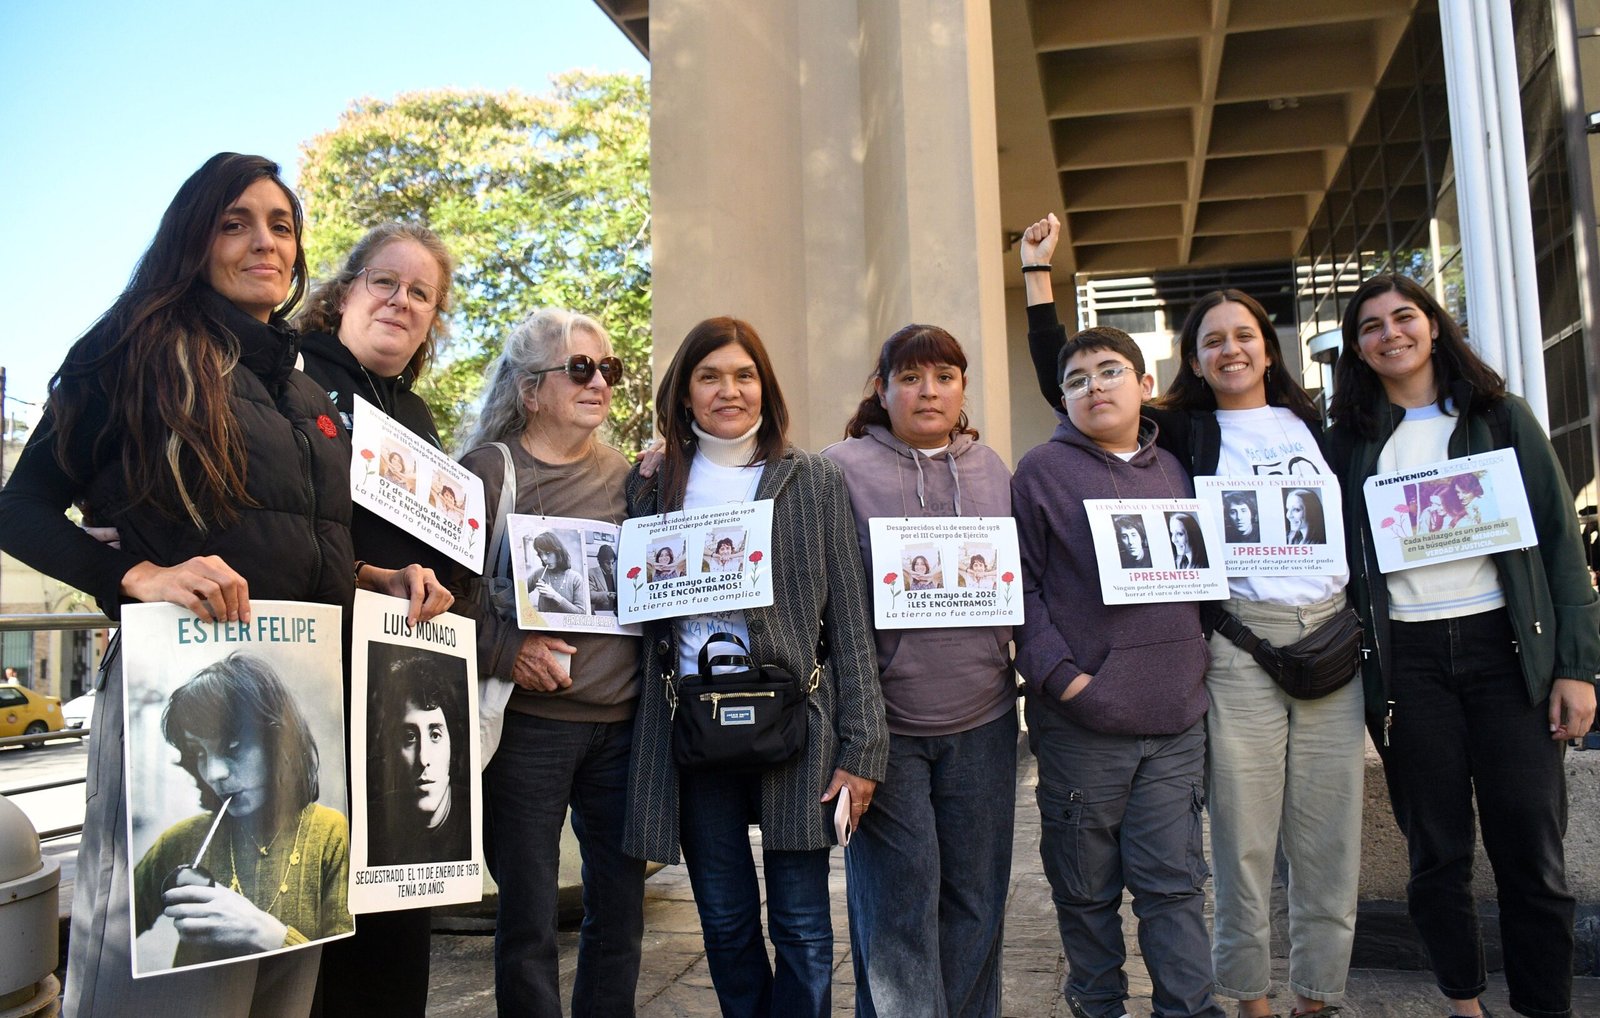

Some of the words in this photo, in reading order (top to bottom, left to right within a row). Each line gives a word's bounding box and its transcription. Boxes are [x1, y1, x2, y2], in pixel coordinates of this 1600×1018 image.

[1375, 469, 1438, 487] ¡BIENVENIDOS
[378, 487, 396, 504] ¡LES
[400, 500, 461, 543] ENCONTRAMOS!
[379, 478, 390, 490] 07
[392, 486, 402, 498] de
[405, 494, 428, 516] mayo
[431, 510, 441, 522] de
[442, 518, 462, 534] 2026
[355, 485, 367, 494] La
[371, 492, 400, 515] tierra
[402, 514, 414, 523] no
[417, 521, 432, 534] fue
[434, 532, 474, 559] complice
[638, 516, 685, 529] Desaparecidos
[740, 508, 755, 516] 1978
[650, 527, 660, 535] por
[679, 521, 703, 530] Cuerpo
[713, 516, 740, 525] Ejército
[1422, 532, 1453, 542] hallazgo
[1475, 525, 1492, 533] paso
[1426, 536, 1460, 549] búsqueda
[1233, 546, 1314, 555] ¡PRESENTES!
[662, 581, 673, 589] de
[676, 578, 702, 588] mayo
[720, 573, 742, 581] 2026
[1129, 570, 1200, 582] ¡PRESENTES!
[643, 600, 672, 610] tierra
[692, 596, 709, 604] fue
[713, 590, 761, 601] complice
[649, 591, 668, 600] ¡LES
[671, 582, 742, 596] ENCONTRAMOS!
[934, 592, 959, 600] mayo
[930, 599, 996, 608] ENCONTRAMOS!
[970, 609, 1013, 617] complice
[178, 616, 251, 644] ESTER
[258, 616, 316, 644] FELIPE
[384, 612, 412, 637] LUIS
[416, 621, 457, 648] MONACO
[356, 868, 404, 884] SECUESTRADO
[408, 868, 415, 881] EL
[417, 868, 424, 880] 11
[426, 866, 434, 879] DE
[435, 865, 455, 878] ENERO
[456, 865, 464, 877] DE
[466, 864, 479, 876] 1978
[398, 882, 416, 898] TENÍA
[418, 883, 426, 896] 30
[428, 880, 444, 894] AÑOS
